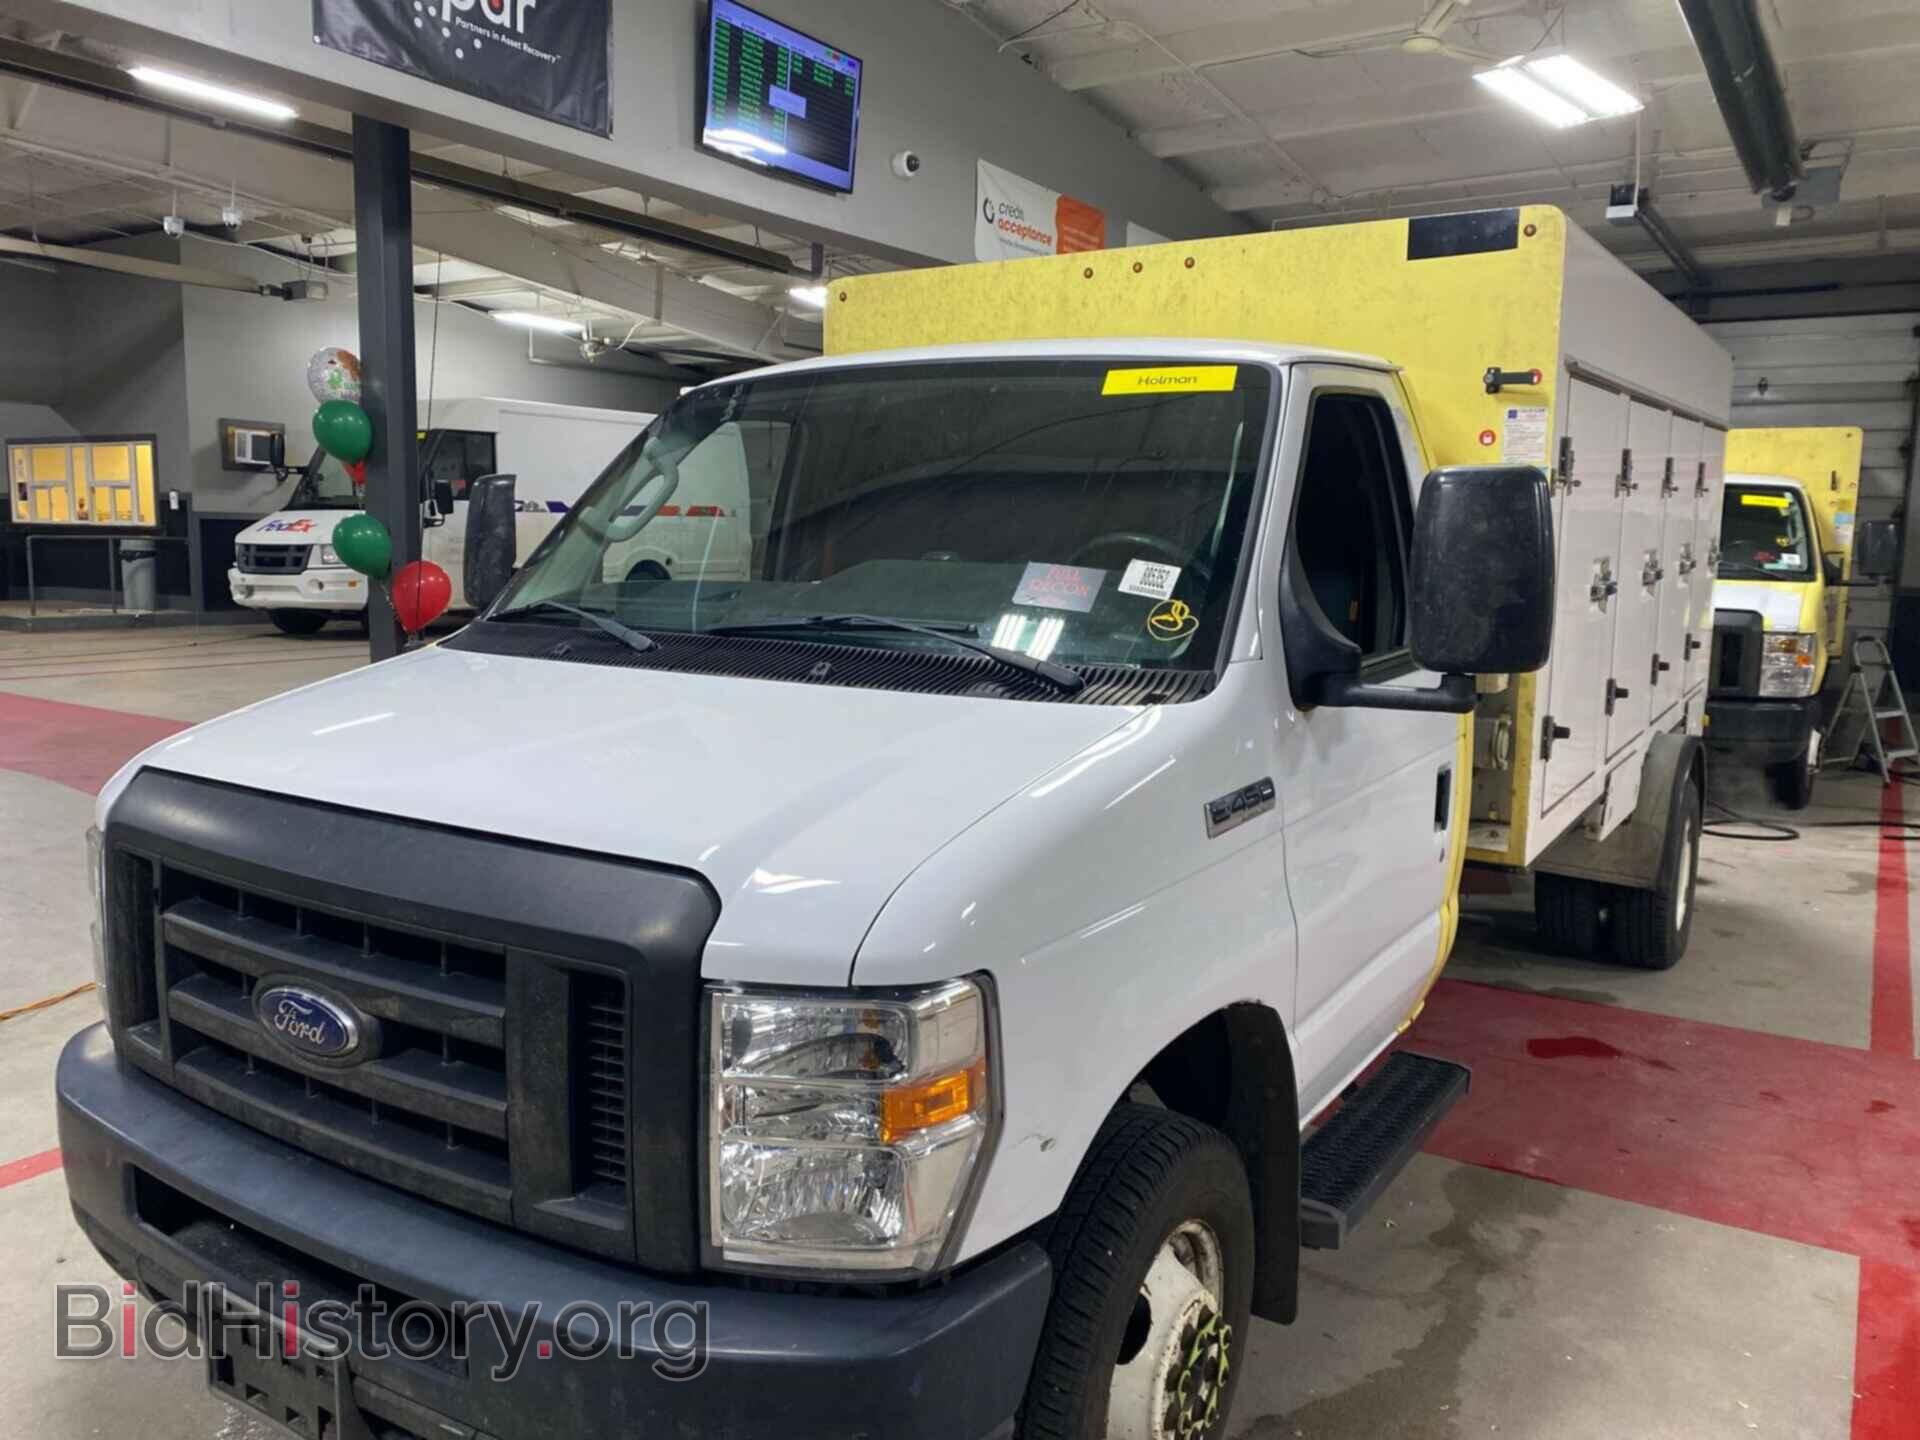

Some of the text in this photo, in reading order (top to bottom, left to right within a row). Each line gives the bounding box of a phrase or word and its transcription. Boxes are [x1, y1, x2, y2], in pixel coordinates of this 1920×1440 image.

[455, 16, 490, 38] Partners
[492, 30, 500, 41] in
[501, 34, 522, 50] Asset
[998, 218, 1053, 246] acceptance
[1137, 375, 1198, 385] Holman
[274, 1000, 325, 1044] Ford
